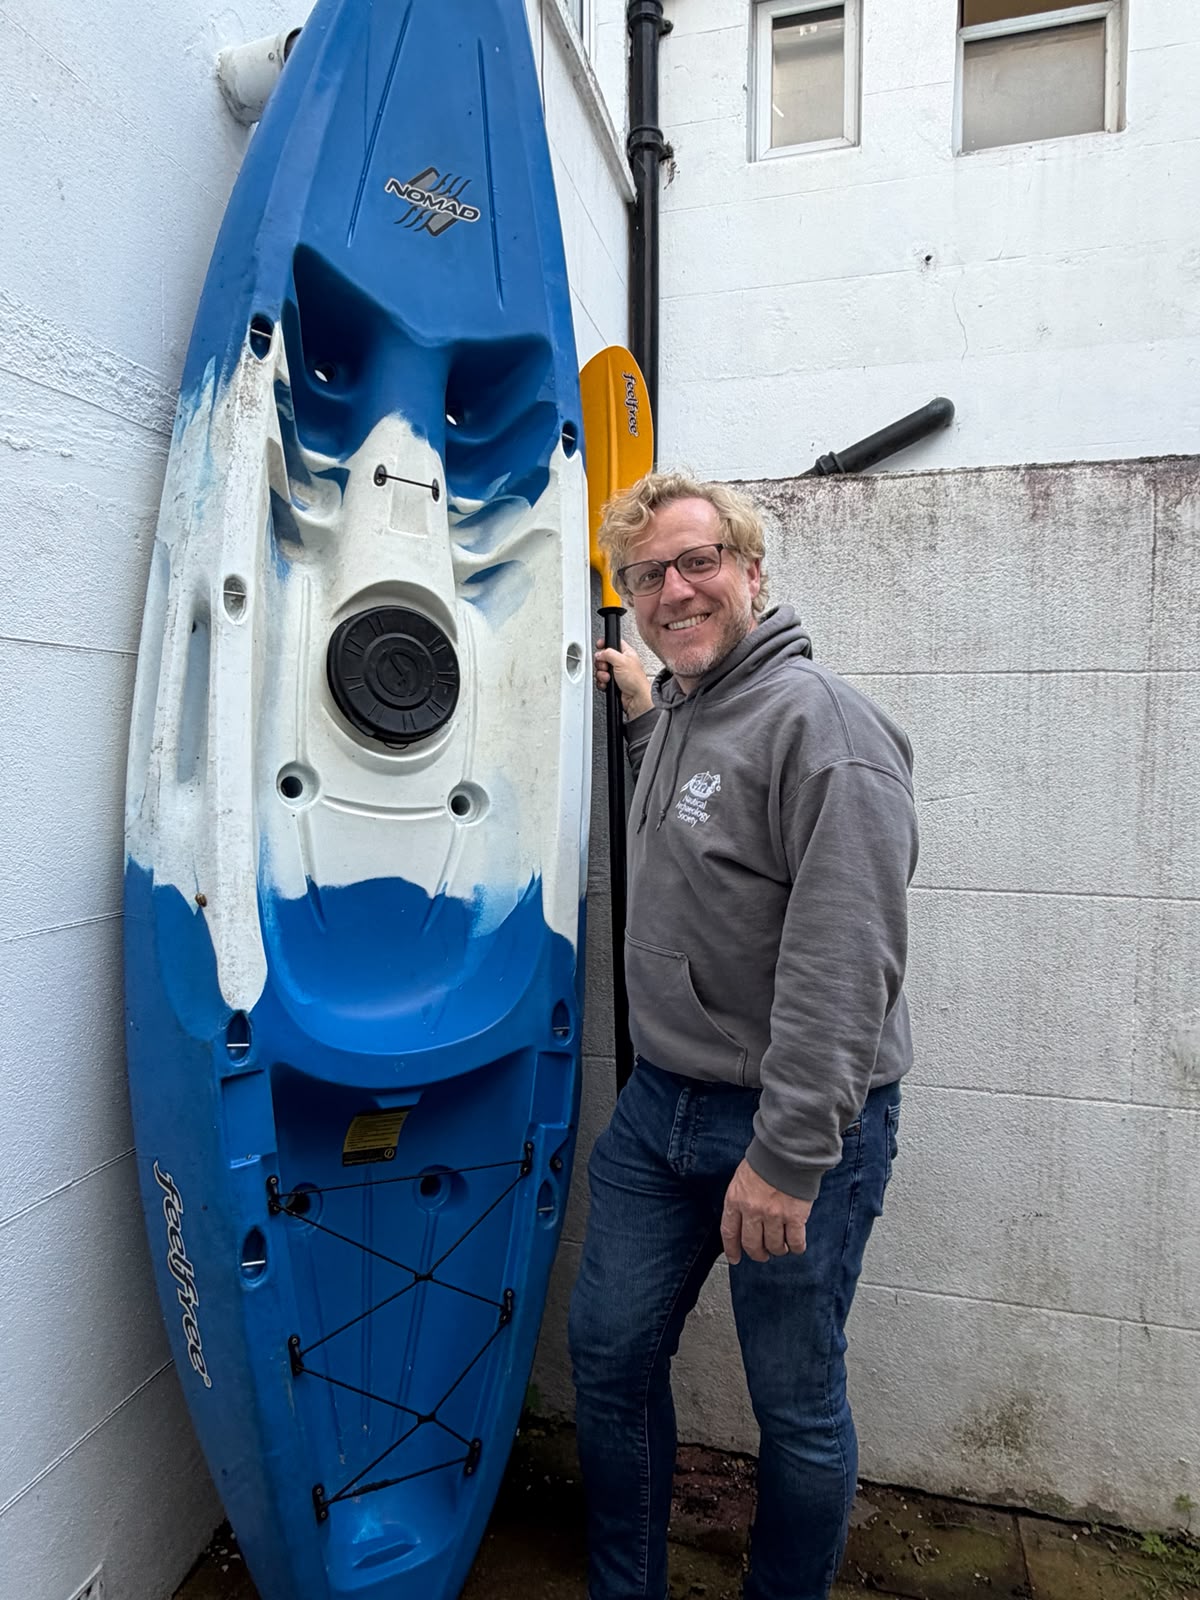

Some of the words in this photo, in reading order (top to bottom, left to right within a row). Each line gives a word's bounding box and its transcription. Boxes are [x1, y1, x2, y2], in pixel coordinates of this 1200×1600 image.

[385, 177, 481, 222] NOMAD
[622, 371, 639, 437] feelfree
[677, 810, 698, 828] Society
